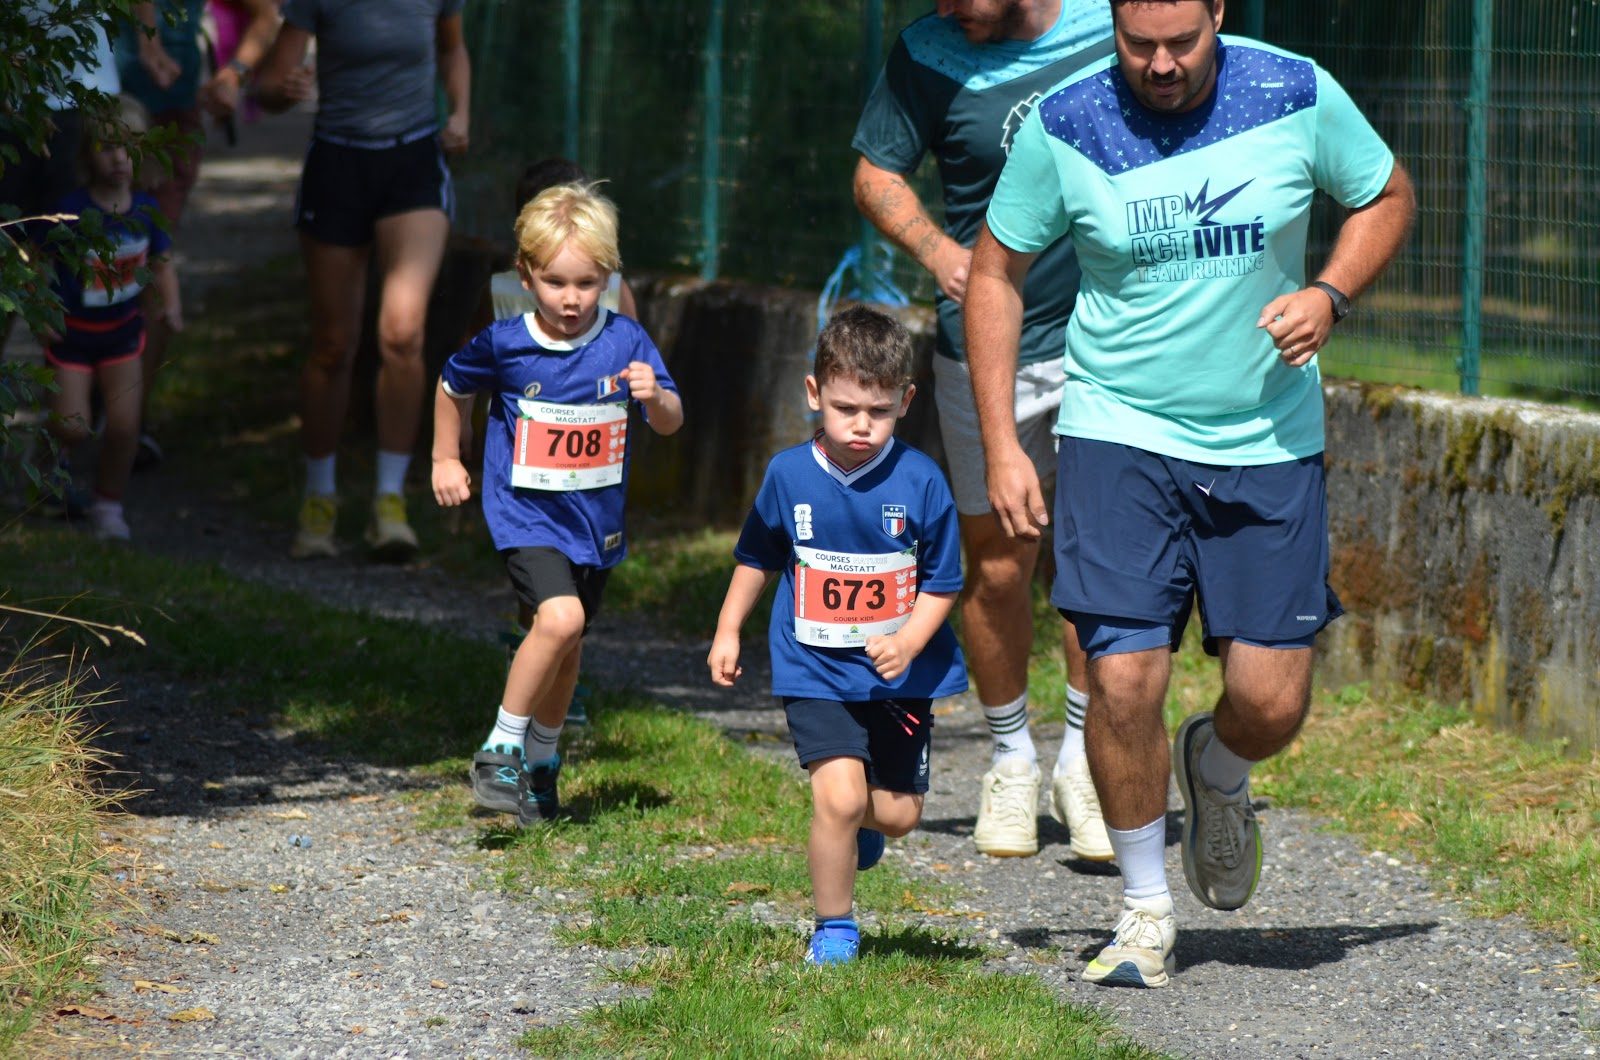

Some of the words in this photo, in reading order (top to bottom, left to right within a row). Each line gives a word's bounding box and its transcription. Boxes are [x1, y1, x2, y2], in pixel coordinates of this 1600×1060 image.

[1126, 195, 1183, 235] IMP
[1132, 230, 1188, 265] ACT
[1193, 216, 1264, 258] IVITÉ
[1136, 262, 1188, 283] TEAM
[1192, 253, 1264, 280] RUNNING
[541, 406, 575, 416] COURSES
[555, 416, 597, 424] MAGSTATT
[547, 429, 602, 458] 708
[815, 552, 850, 563] COURSES
[830, 563, 876, 572] MAGSTATT
[822, 577, 886, 610] 673
